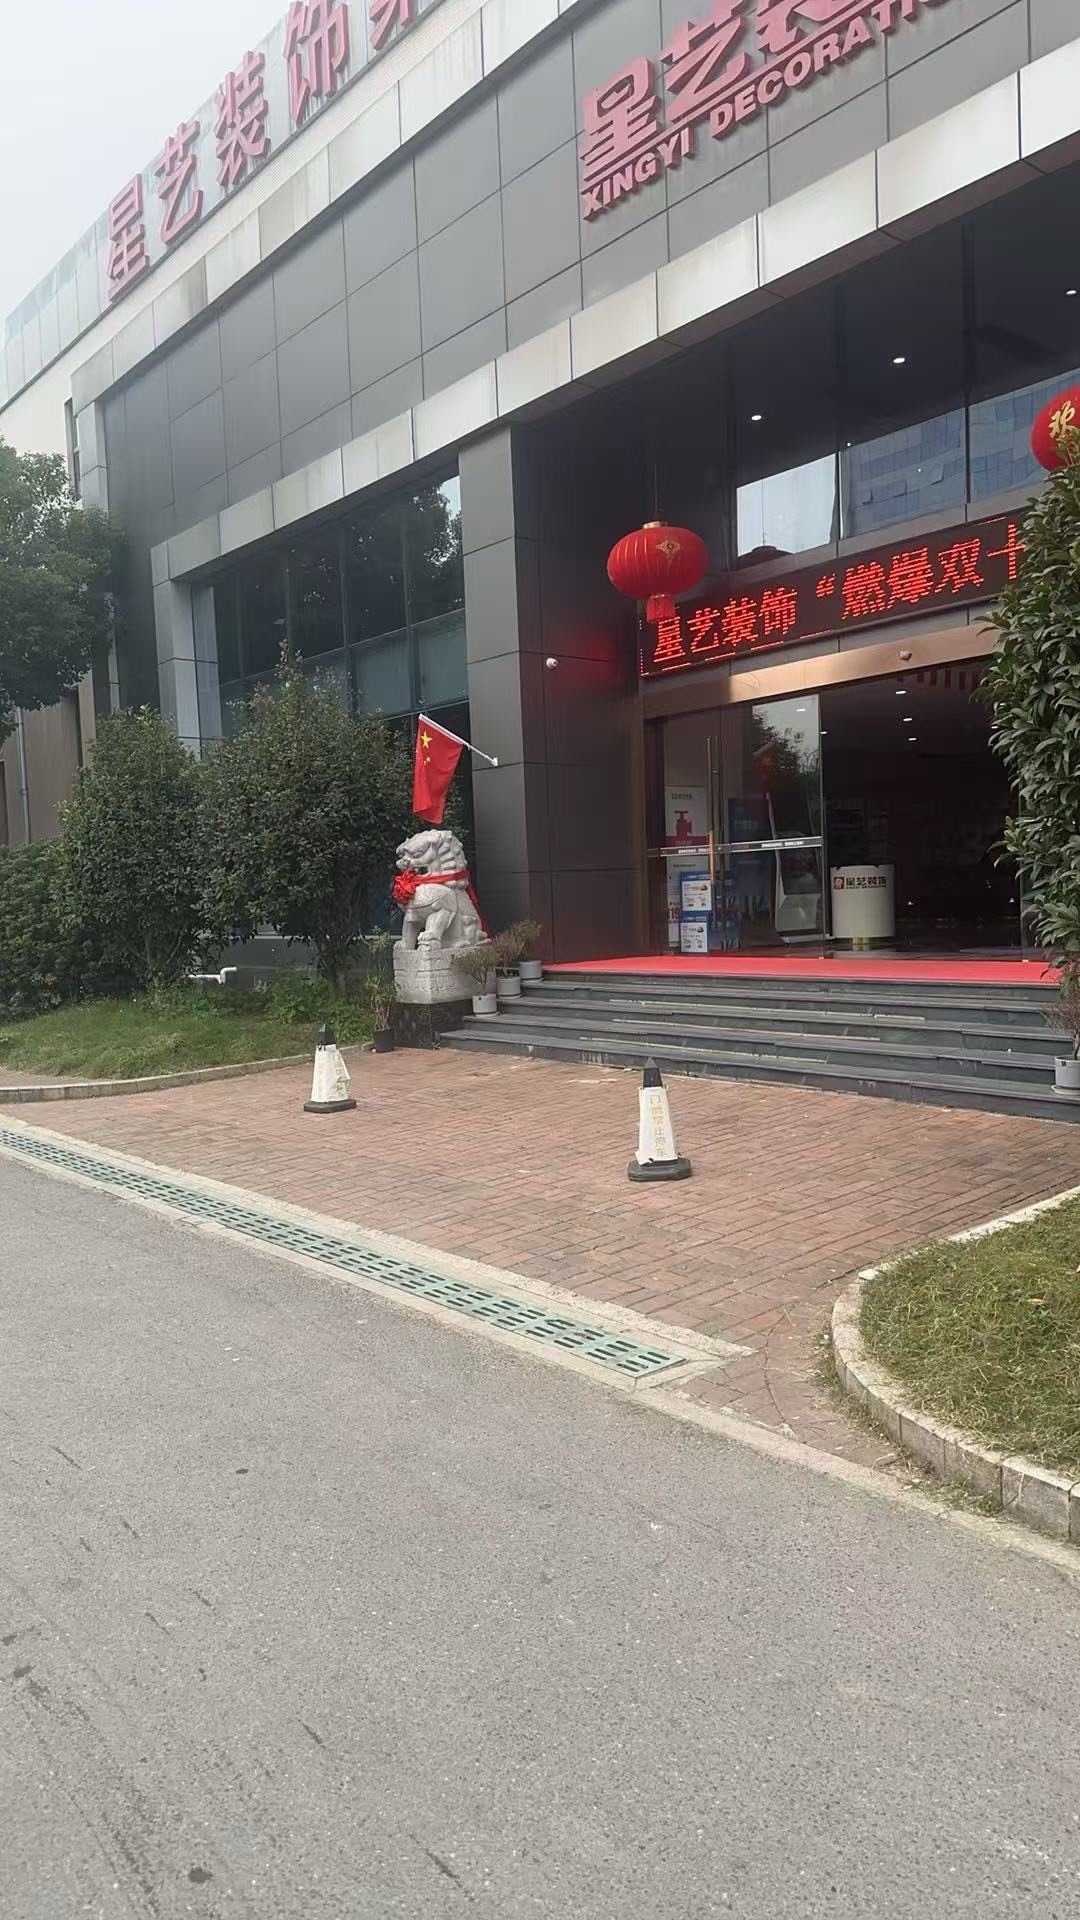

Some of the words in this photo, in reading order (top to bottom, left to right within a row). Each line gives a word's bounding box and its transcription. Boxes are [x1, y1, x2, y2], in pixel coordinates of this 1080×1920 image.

[107, 0, 414, 302] 星艺装饰
[582, 126, 696, 220] XINGYI
[709, 0, 932, 139] DECORATI
